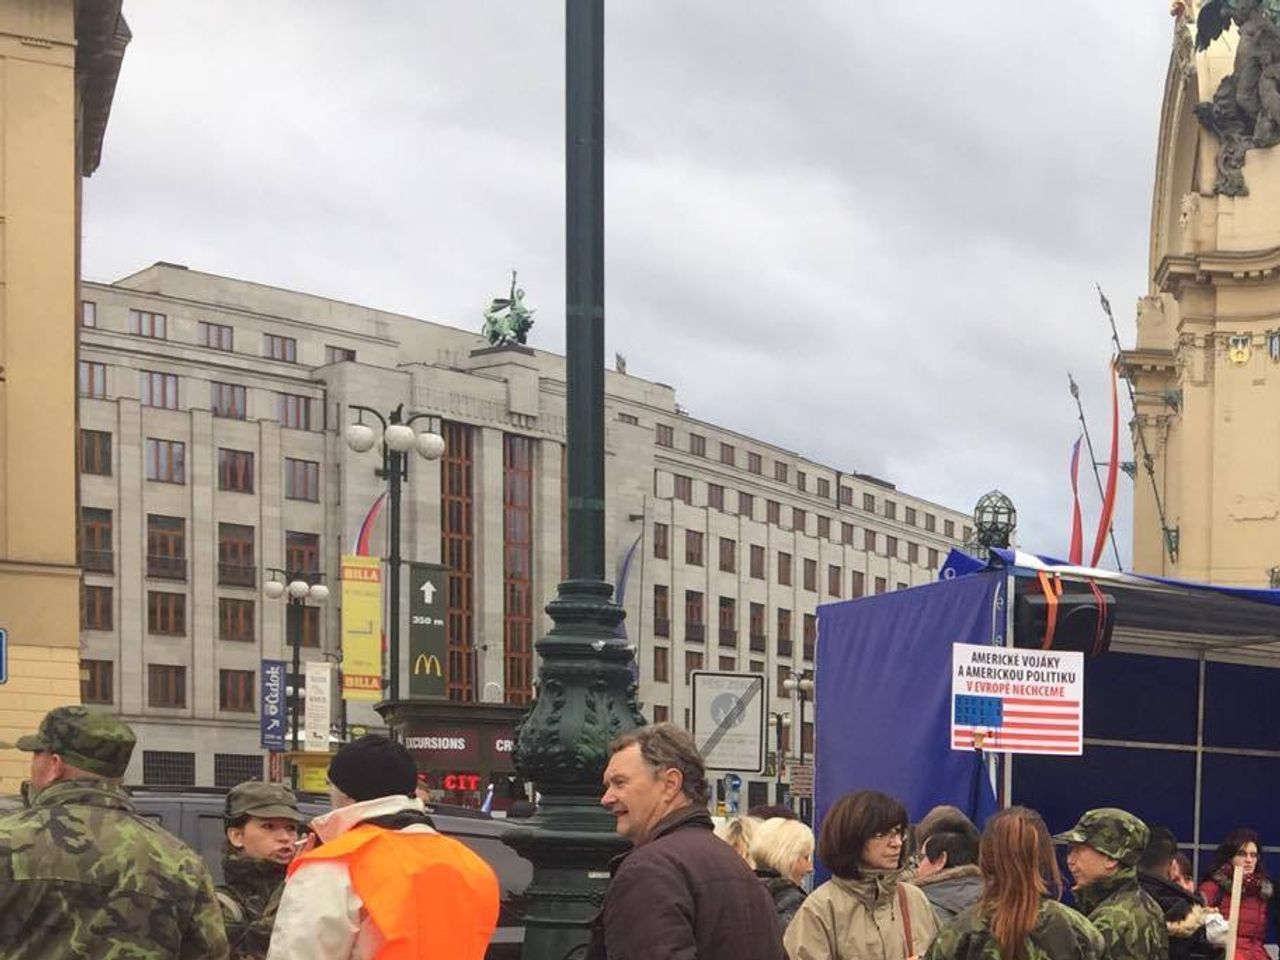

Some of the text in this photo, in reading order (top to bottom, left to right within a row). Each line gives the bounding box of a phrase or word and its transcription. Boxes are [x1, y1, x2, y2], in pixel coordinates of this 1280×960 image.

[958, 665, 1076, 684] A AMERICKOU POLITIKU
[966, 681, 973, 692] V
[1012, 683, 1065, 697] NECHCEME
[495, 739, 514, 752] CR
